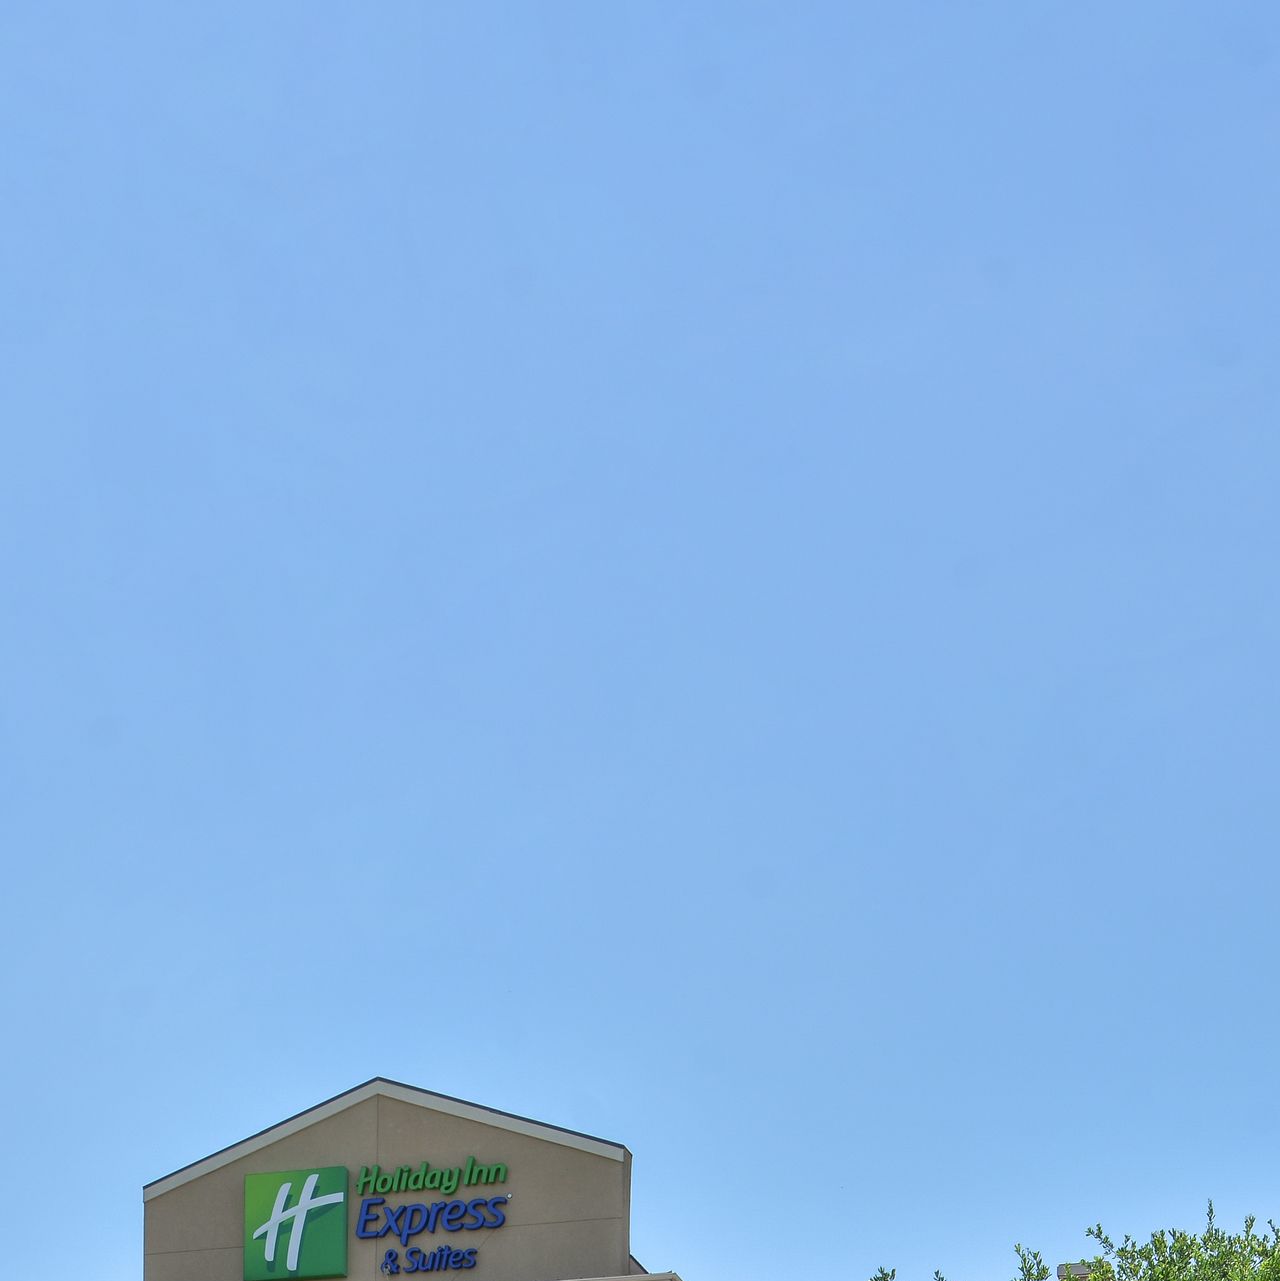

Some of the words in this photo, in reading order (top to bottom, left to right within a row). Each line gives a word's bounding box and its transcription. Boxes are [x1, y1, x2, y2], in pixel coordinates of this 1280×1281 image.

[356, 1161, 461, 1196] Holiday
[463, 1155, 508, 1186] Inn
[253, 1174, 344, 1271] H
[356, 1196, 509, 1247] Express
[381, 1249, 401, 1276] &
[403, 1245, 478, 1274] Suites
